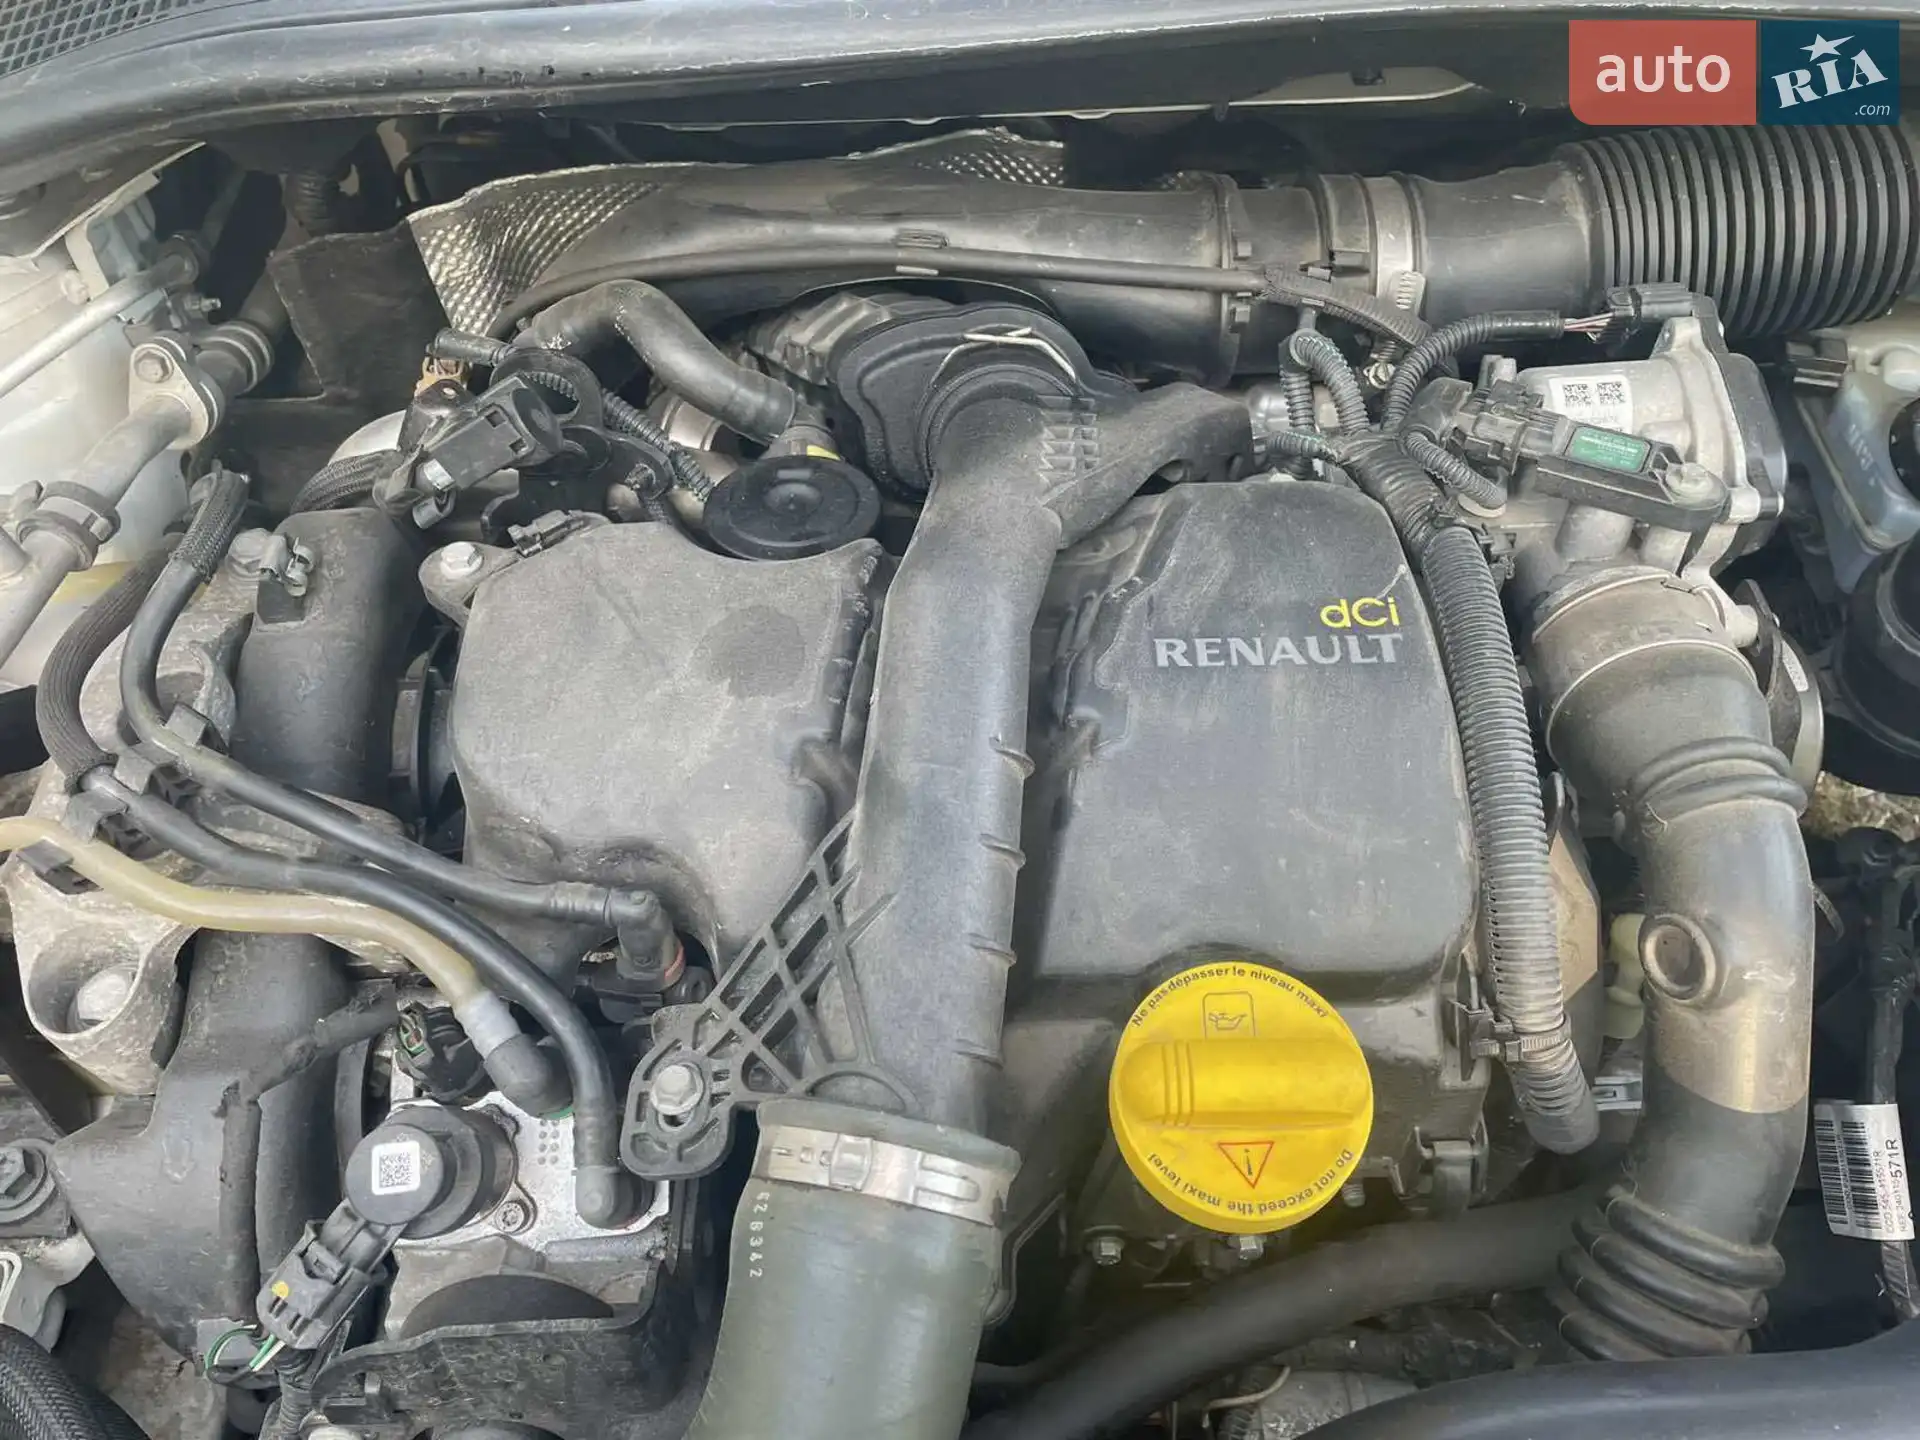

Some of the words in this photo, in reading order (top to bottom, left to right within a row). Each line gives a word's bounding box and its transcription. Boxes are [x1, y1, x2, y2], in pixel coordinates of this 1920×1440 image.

[1319, 596, 1402, 629] dCi
[1152, 632, 1404, 668] RENAULT
[1131, 1008, 1149, 1028] Ne
[1148, 988, 1170, 1011] pas
[1168, 967, 1230, 993] dépasser
[1232, 965, 1246, 977] le
[1249, 968, 1296, 993] niveau
[1295, 988, 1329, 1019] maxi
[1147, 1152, 1183, 1189] level
[1335, 1148, 1354, 1169] Do
[1182, 1182, 1222, 1208] maxi
[1314, 1170, 1337, 1191] not
[1226, 1201, 1255, 1216] the
[1258, 1187, 1315, 1216] exceed
